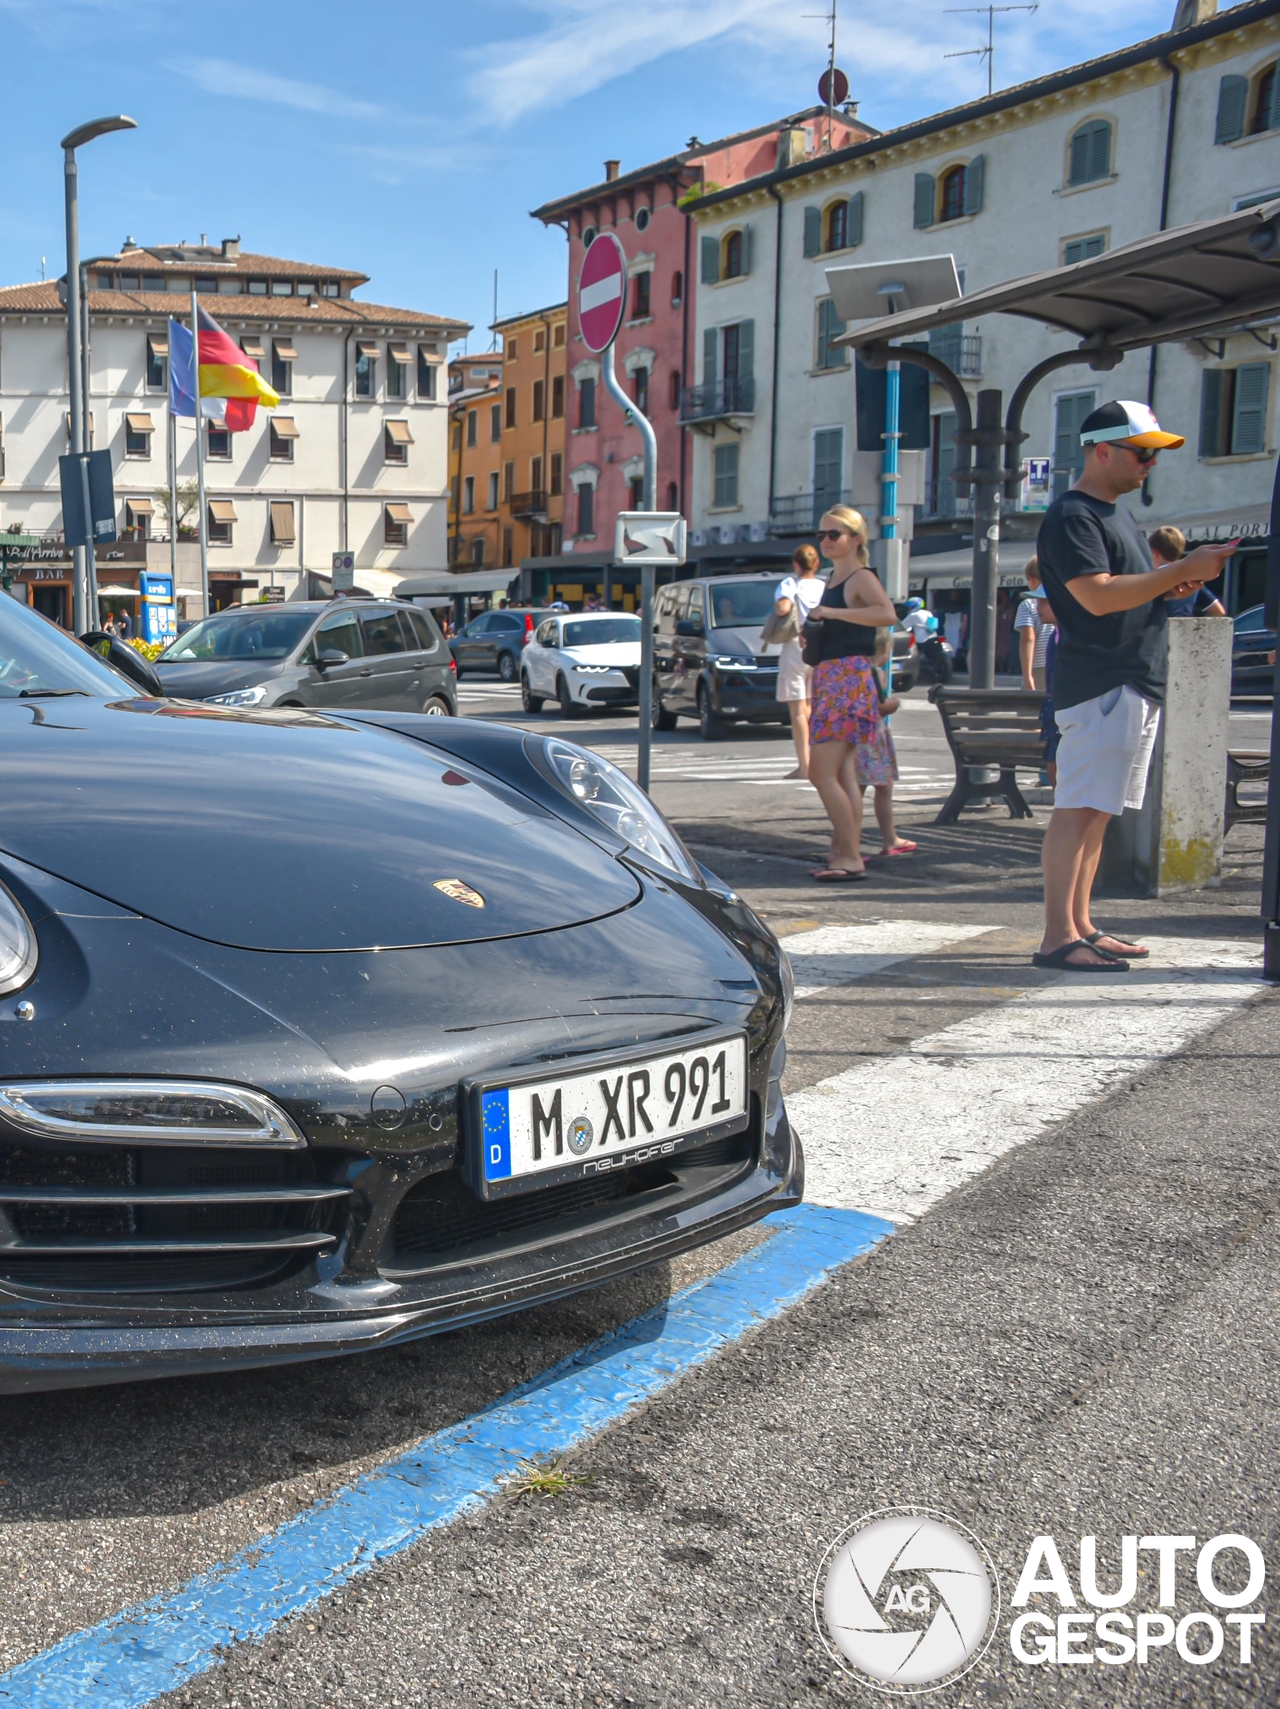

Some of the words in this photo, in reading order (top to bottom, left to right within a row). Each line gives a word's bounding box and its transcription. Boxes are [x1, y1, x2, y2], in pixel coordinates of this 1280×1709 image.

[35, 570, 64, 580] BAR
[1000, 575, 1023, 588] Foto
[530, 1088, 564, 1161] M
[598, 1069, 654, 1146] XR
[664, 1050, 731, 1127] 991
[490, 1144, 502, 1164] D
